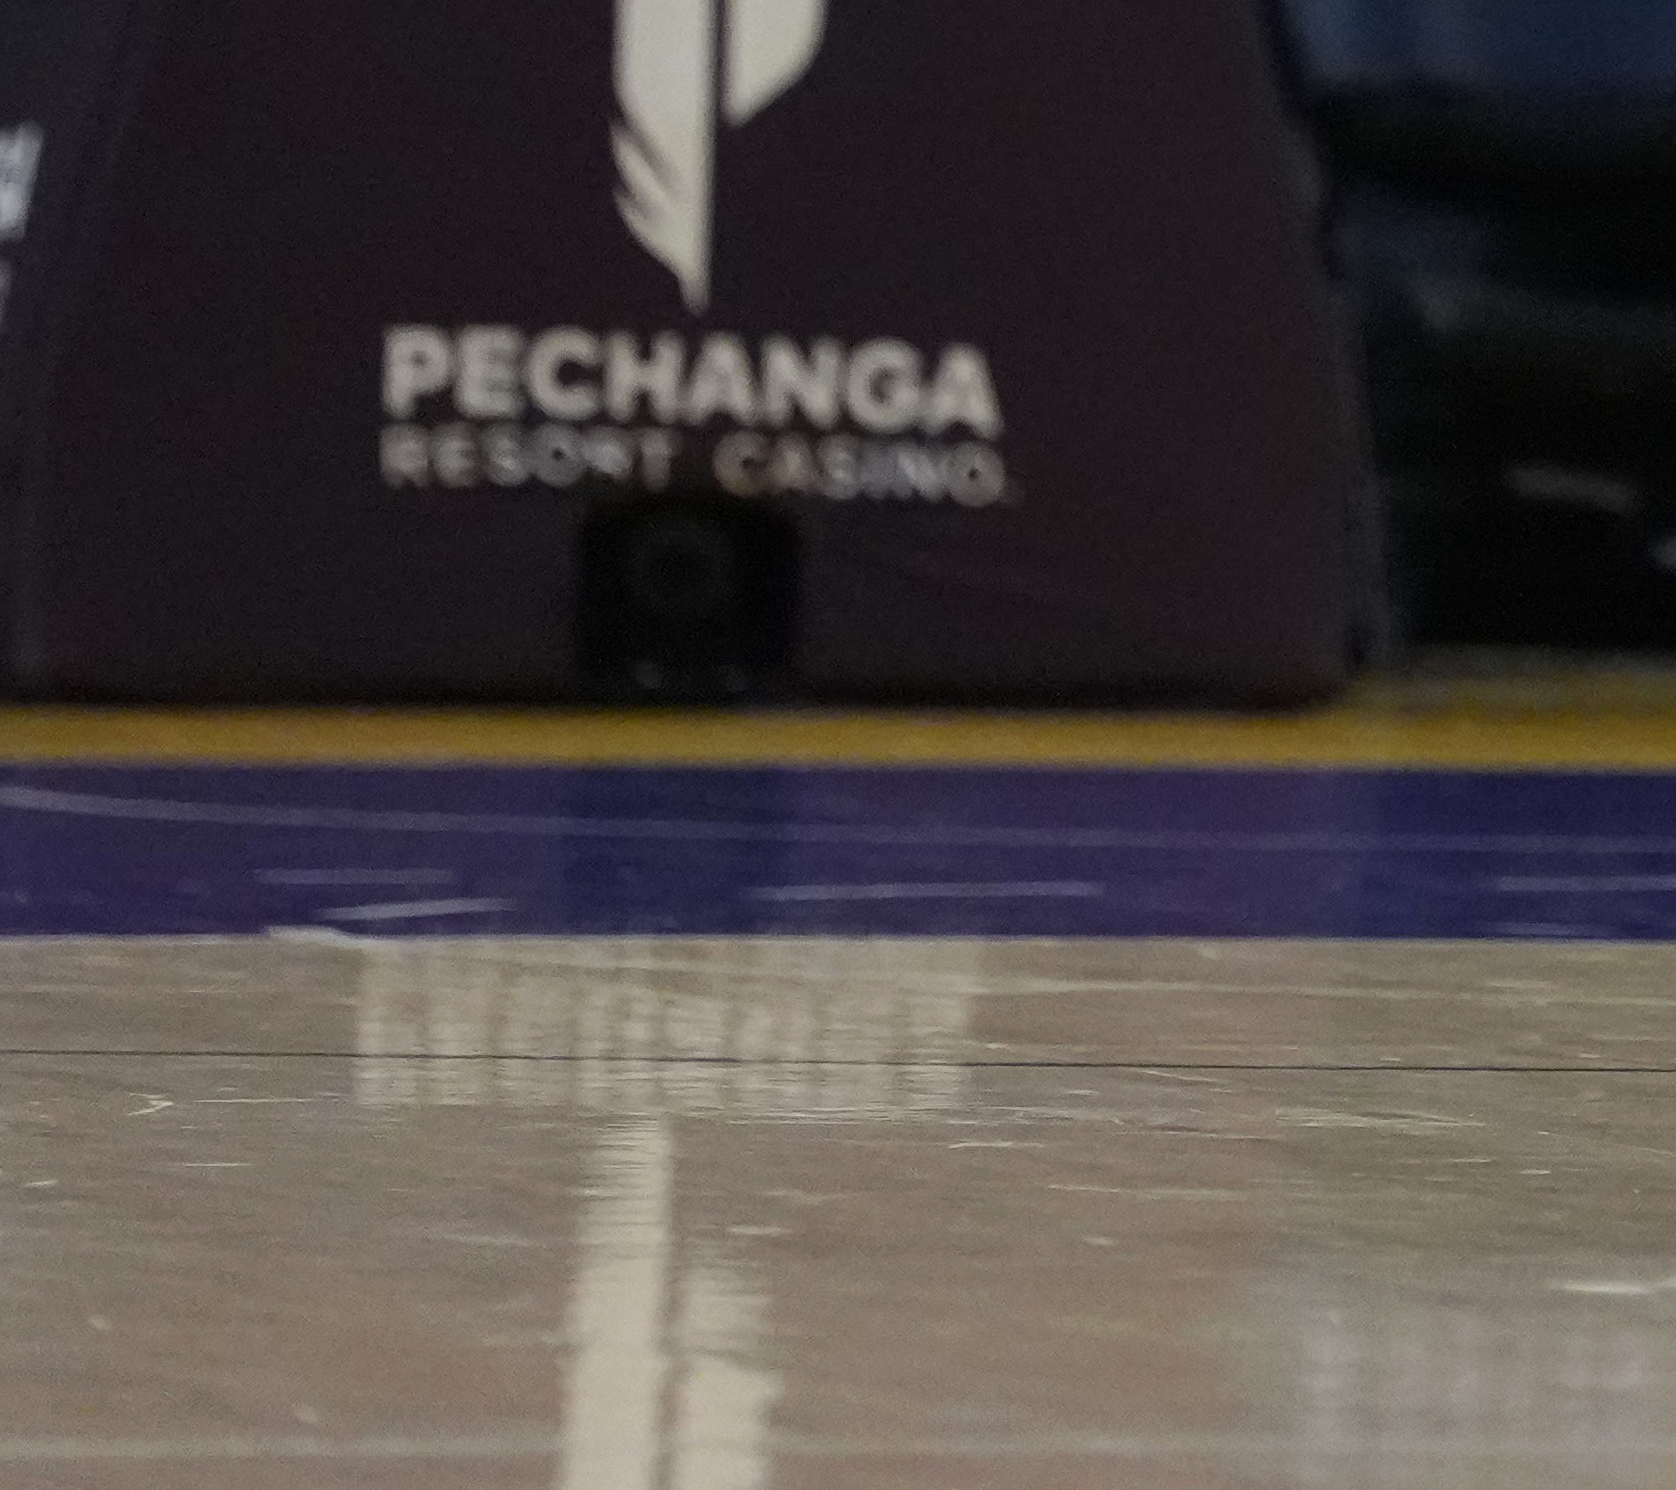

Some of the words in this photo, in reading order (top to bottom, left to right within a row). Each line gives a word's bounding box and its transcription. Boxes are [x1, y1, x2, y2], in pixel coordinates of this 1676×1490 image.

[382, 325, 1003, 441] PECHANGA
[380, 423, 682, 490] RESORT
[712, 429, 1006, 509] CASINO
